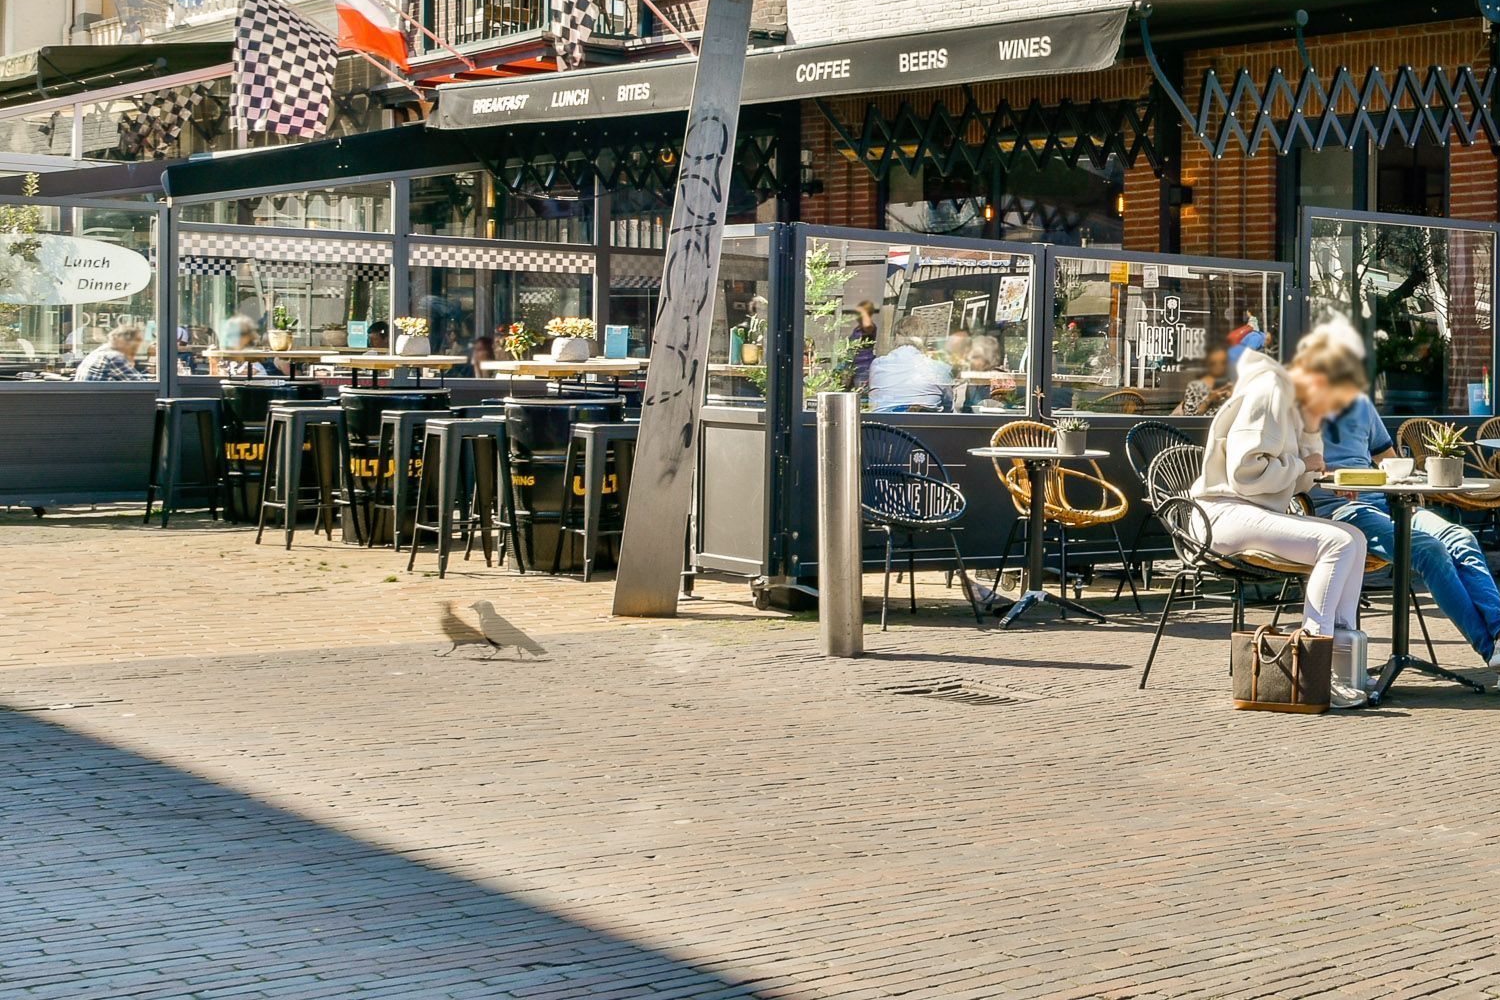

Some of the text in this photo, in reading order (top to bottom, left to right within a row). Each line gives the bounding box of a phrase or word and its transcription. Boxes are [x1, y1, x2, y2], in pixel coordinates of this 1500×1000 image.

[472, 36, 1052, 115] BREAKFAST LUNCH BITES COFFEE BEERS WINES
[64, 255, 111, 269] Lunch
[77, 278, 132, 291] Dinner
[1136, 321, 1206, 362] NOBLE TREE
